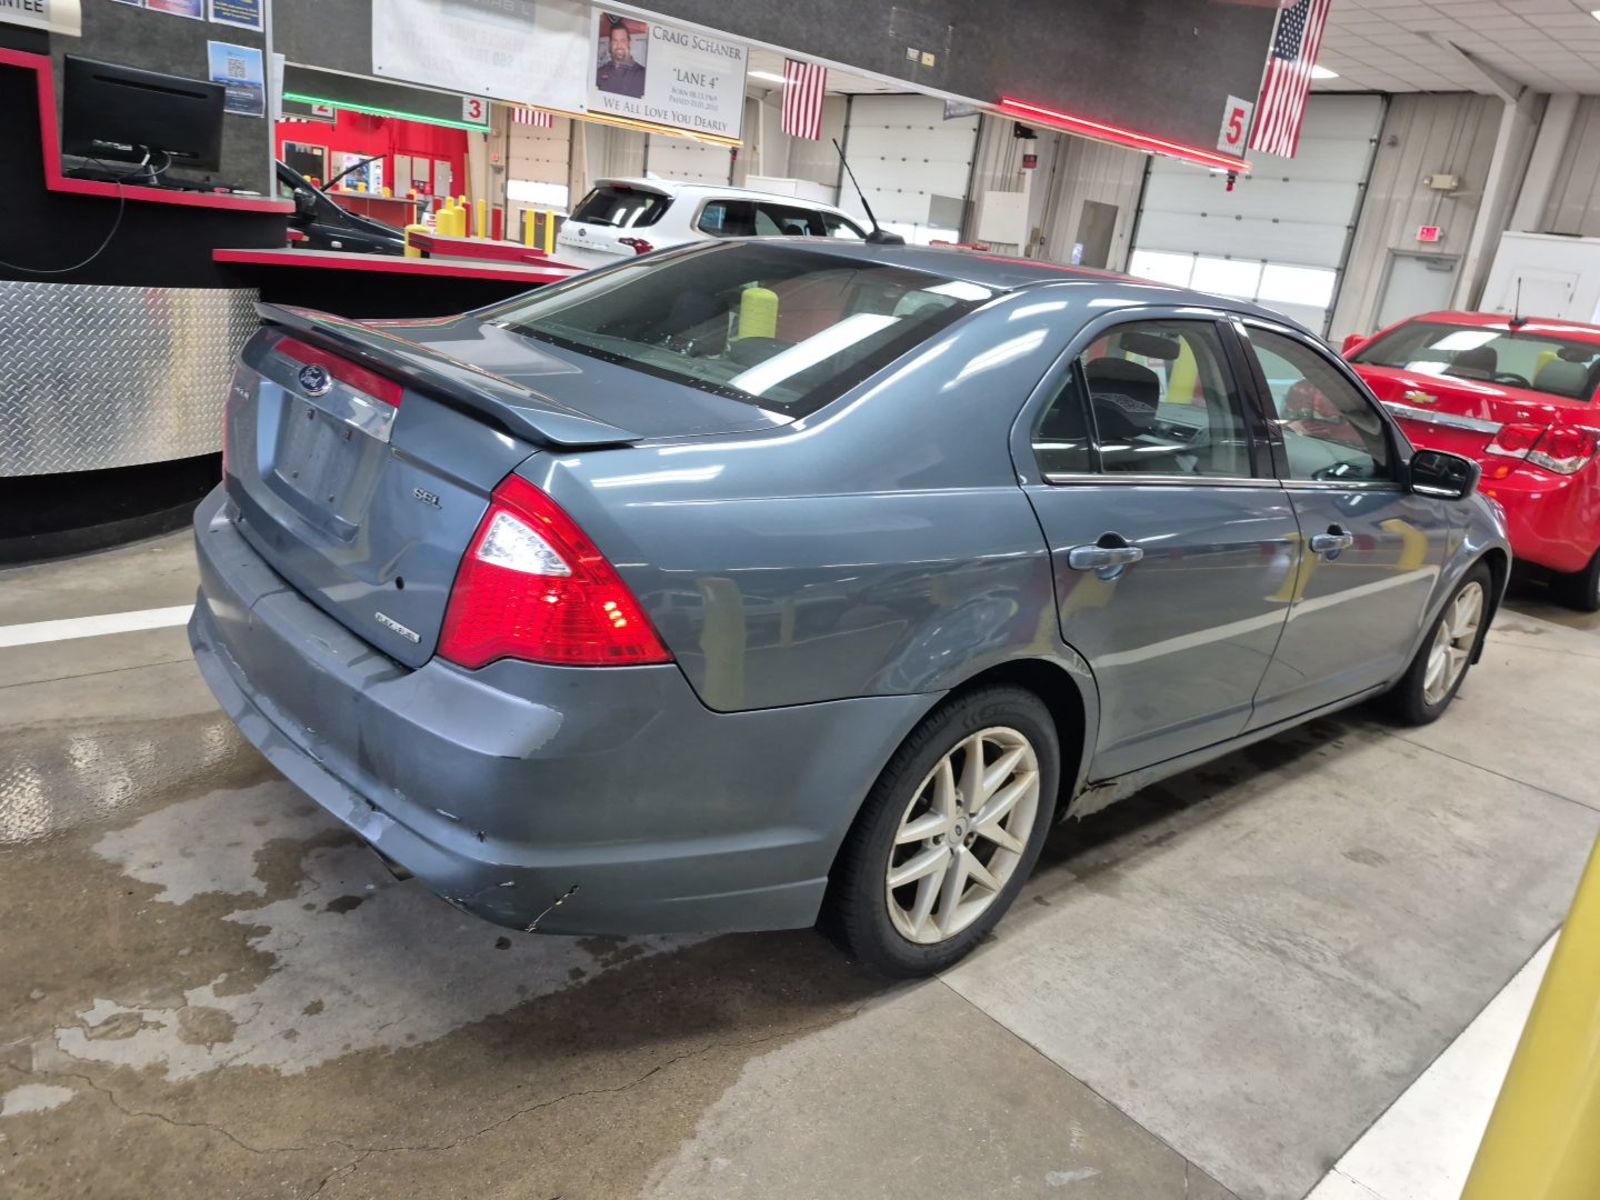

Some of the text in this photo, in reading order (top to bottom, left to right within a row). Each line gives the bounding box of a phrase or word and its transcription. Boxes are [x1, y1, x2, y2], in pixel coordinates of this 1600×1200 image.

[652, 26, 741, 60] CRAIG SCHANER
[468, 99, 481, 119] 3
[603, 96, 728, 131] WE ALL LOVE YOU DEARLY
[1226, 107, 1245, 145] 5
[413, 487, 442, 510] SEL
